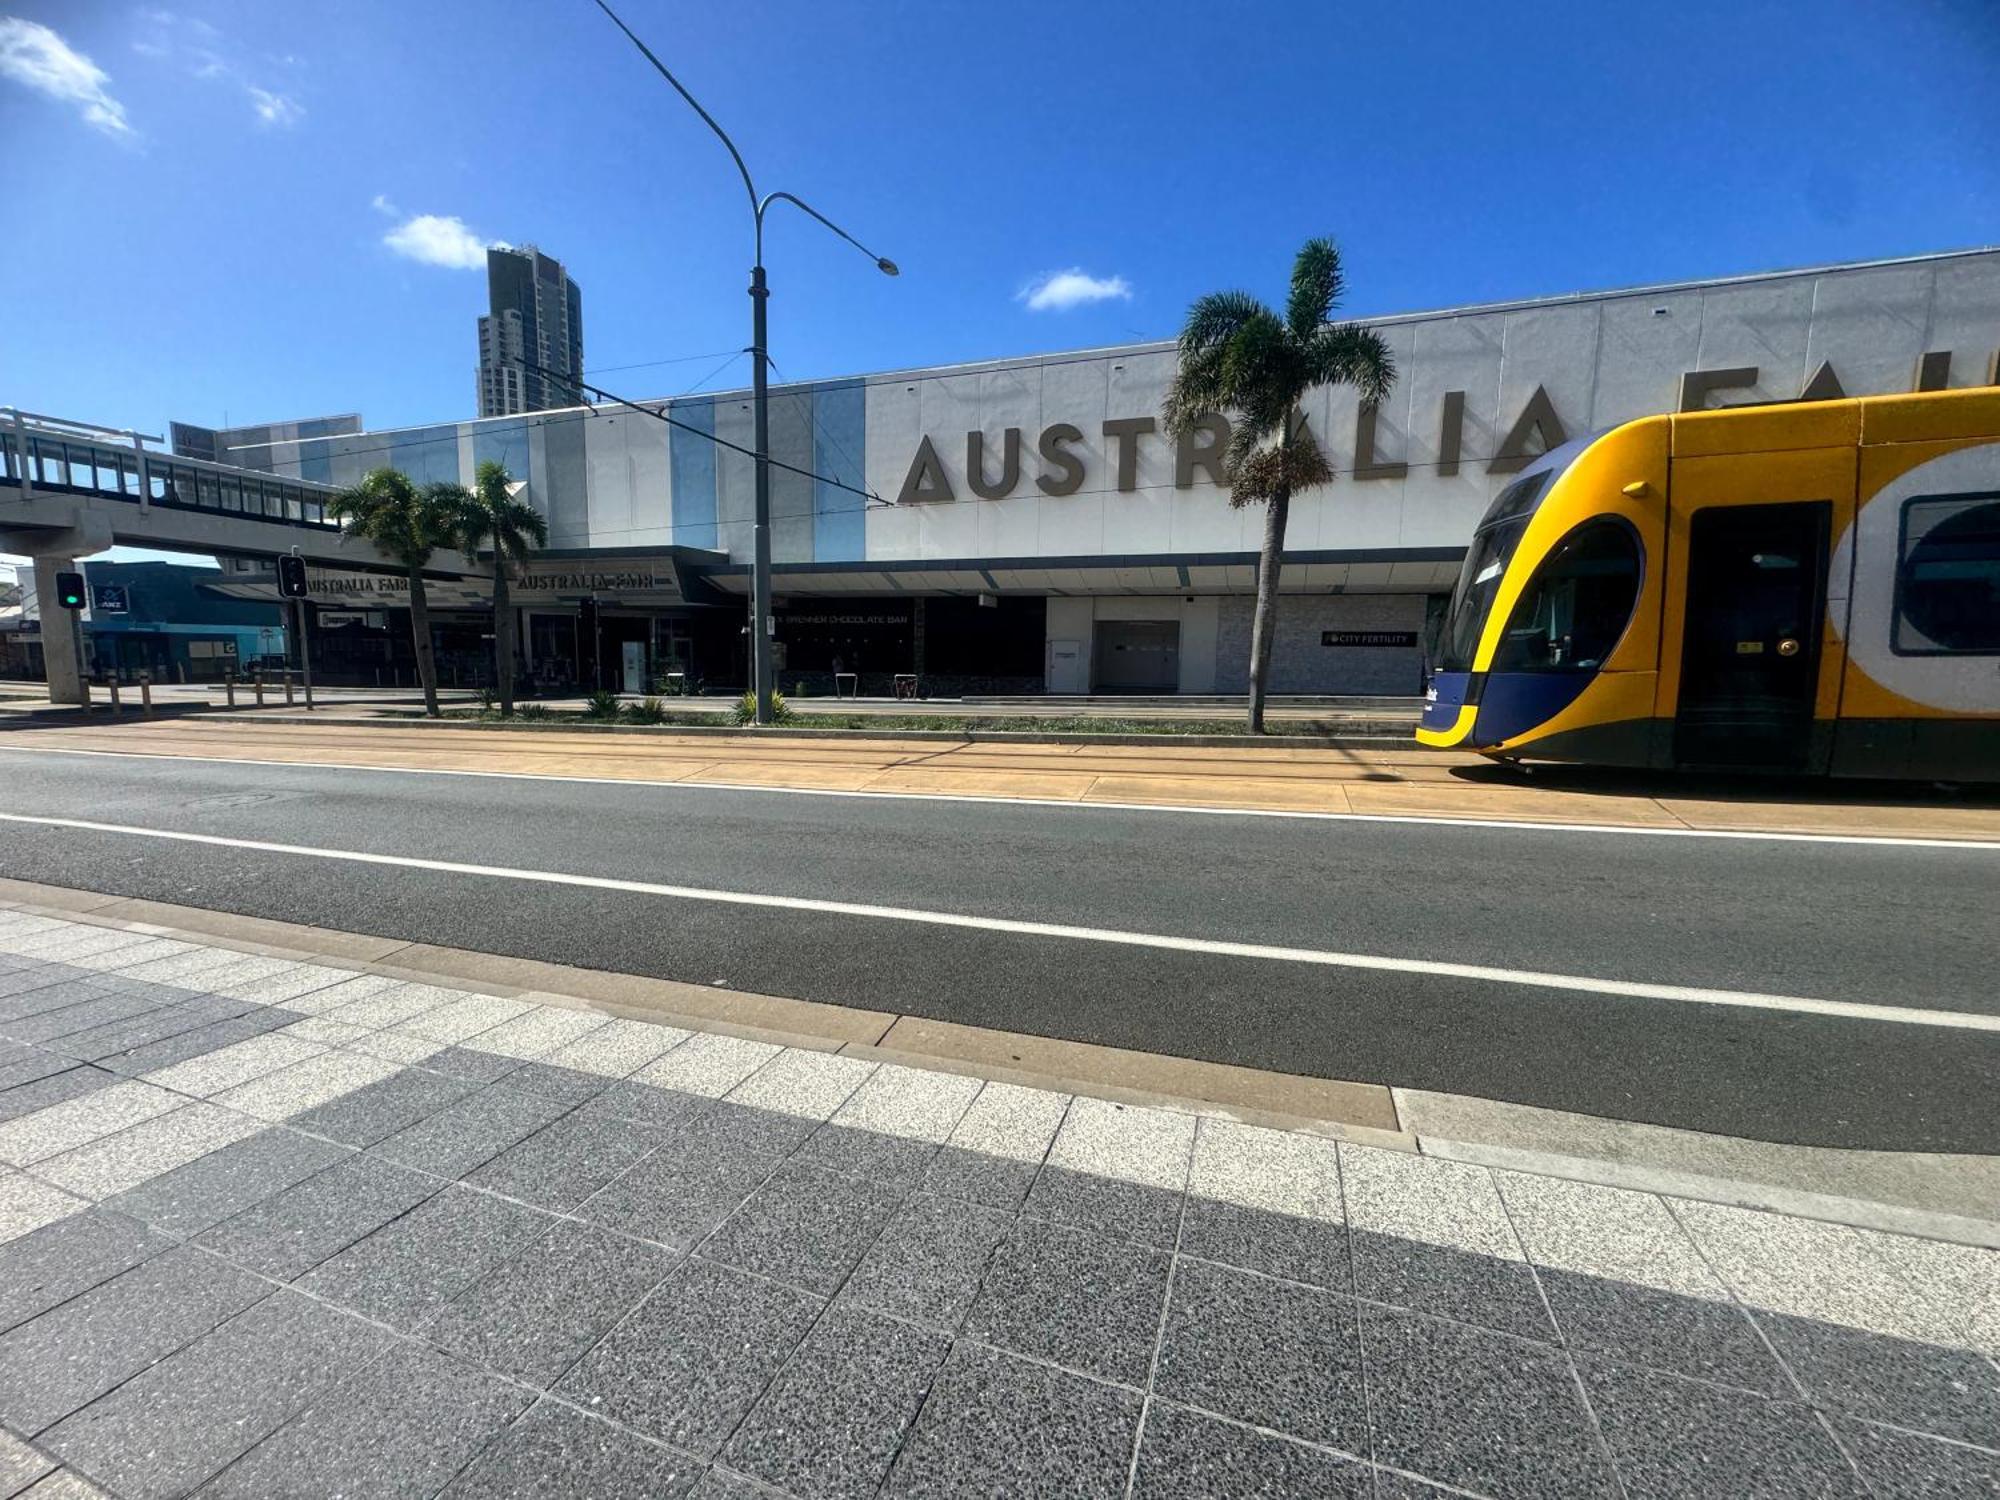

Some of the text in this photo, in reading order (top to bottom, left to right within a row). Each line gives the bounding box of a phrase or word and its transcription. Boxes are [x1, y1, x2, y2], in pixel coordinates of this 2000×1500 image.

[896, 384, 1567, 502] AUSTRLIA
[518, 573, 653, 590] AUSTRALIA FAIR
[1339, 634, 1408, 644] CITY FERTILITY
